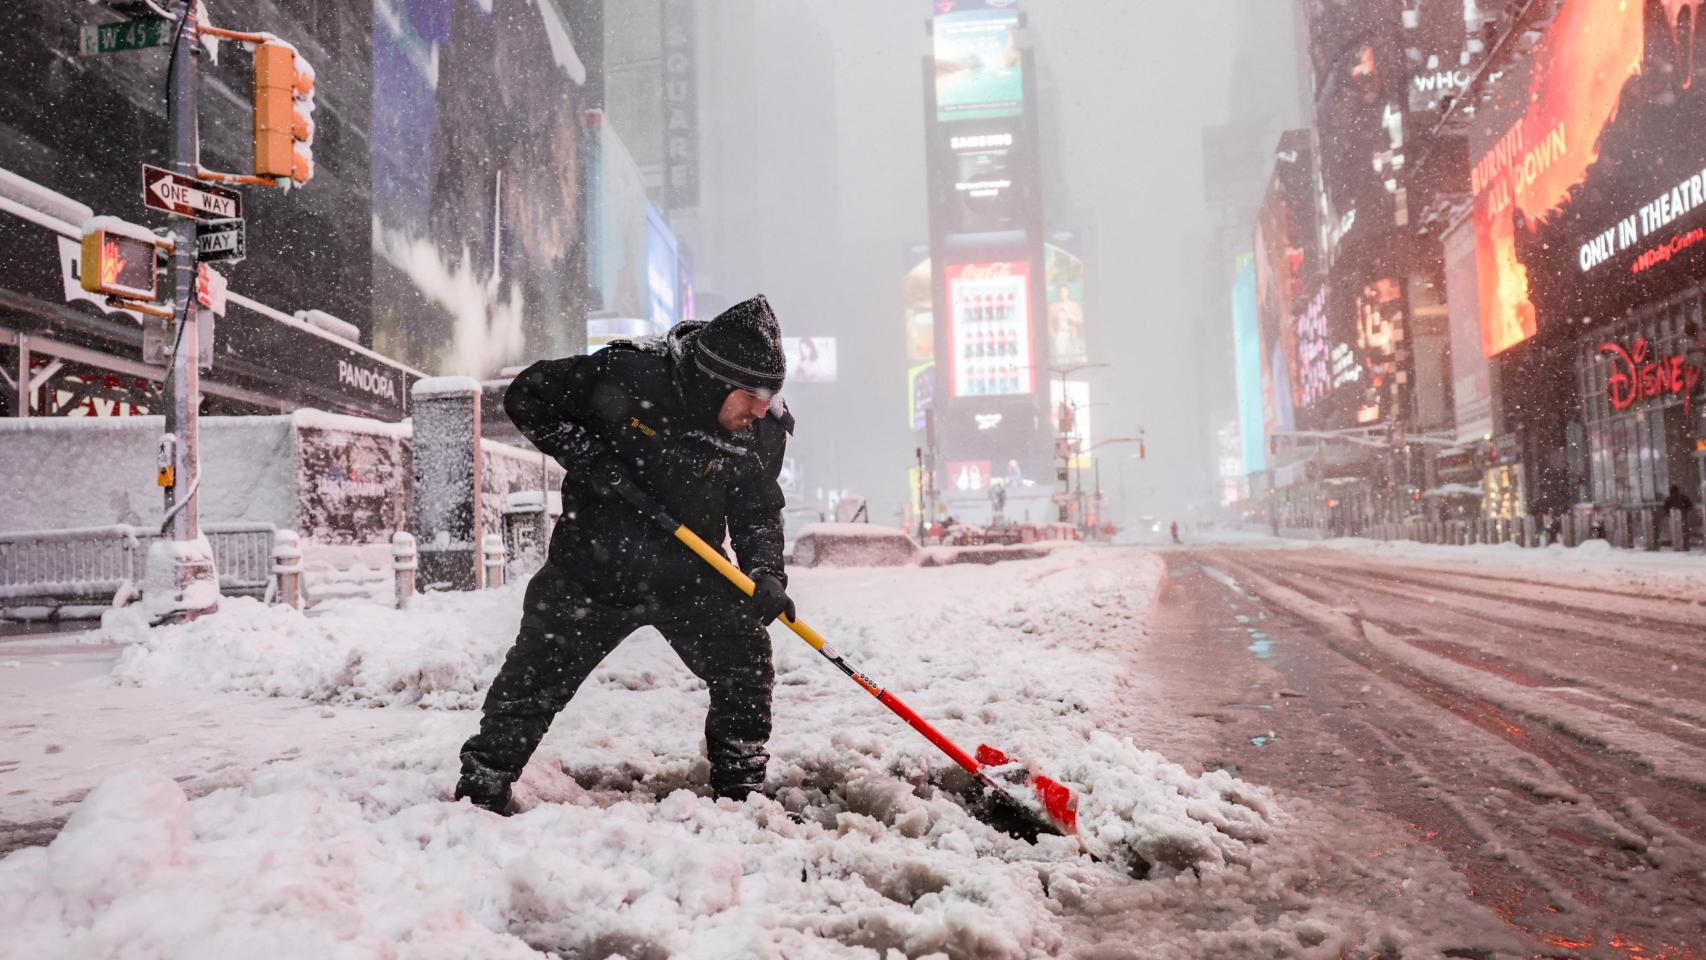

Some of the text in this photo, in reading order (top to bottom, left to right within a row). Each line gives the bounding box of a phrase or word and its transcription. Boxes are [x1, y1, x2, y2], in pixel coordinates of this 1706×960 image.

[101, 27, 119, 49] W
[126, 23, 146, 47] 45
[950, 133, 1013, 149] SAMSUNG
[1514, 121, 1566, 196] DOWN
[160, 183, 230, 214] ONE WAY
[201, 234, 230, 250] WAY
[1580, 227, 1615, 272] ONLY
[1618, 214, 1638, 250] IN
[339, 360, 394, 398] PANDORA
